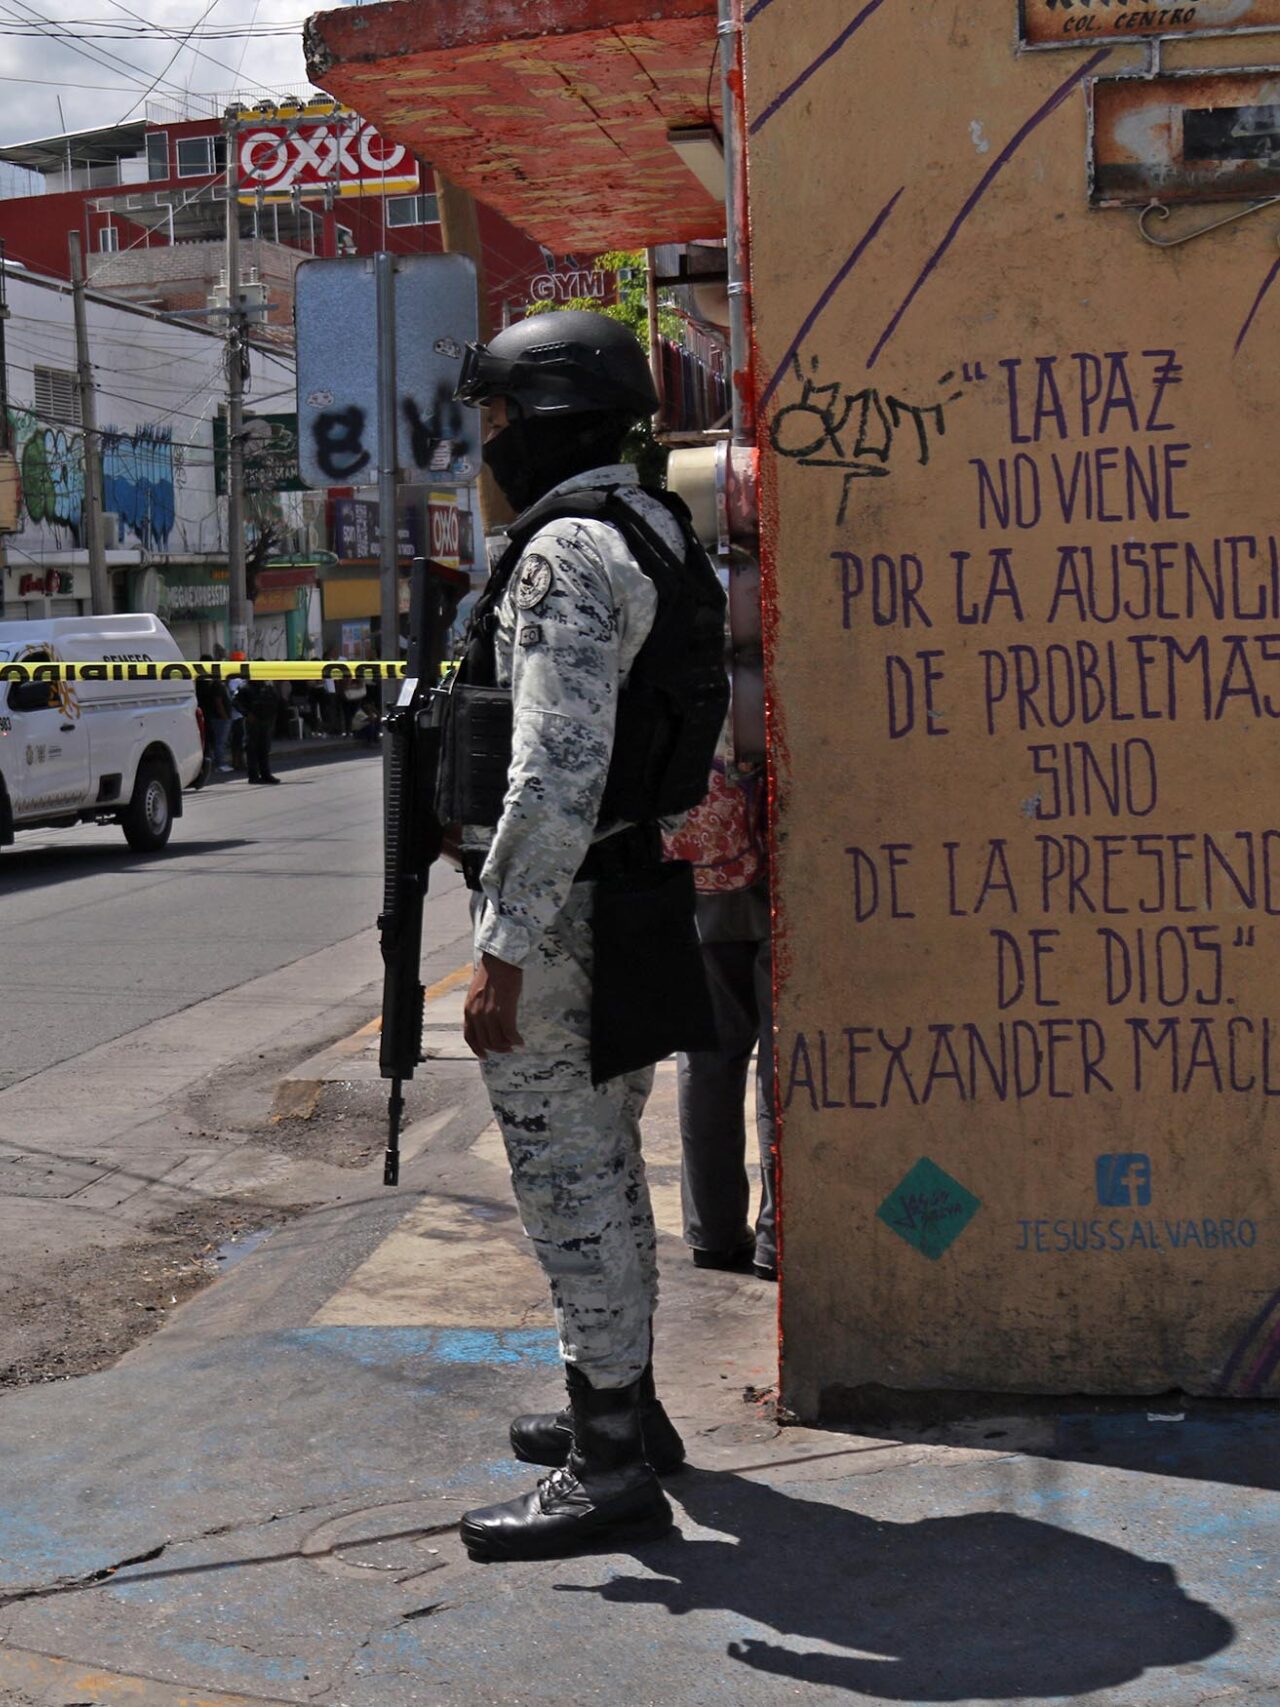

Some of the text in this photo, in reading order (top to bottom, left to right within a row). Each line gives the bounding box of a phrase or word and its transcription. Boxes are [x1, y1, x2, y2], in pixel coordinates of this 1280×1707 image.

[1062, 8, 1196, 33] COL. CENTRO
[240, 118, 407, 190] OXXO
[529, 268, 606, 302] GYM
[1071, 350, 1184, 437] PAZ
[968, 443, 1191, 530] NO VIENE
[830, 551, 932, 629] POR
[950, 548, 1024, 624] LA
[886, 635, 1280, 739] DE PROBLEMAS
[1027, 737, 1157, 820] SINO
[845, 843, 915, 923] DE
[942, 839, 1019, 916] LA
[990, 928, 1061, 1009] DE
[785, 1018, 1114, 1111] ALEXANDER
